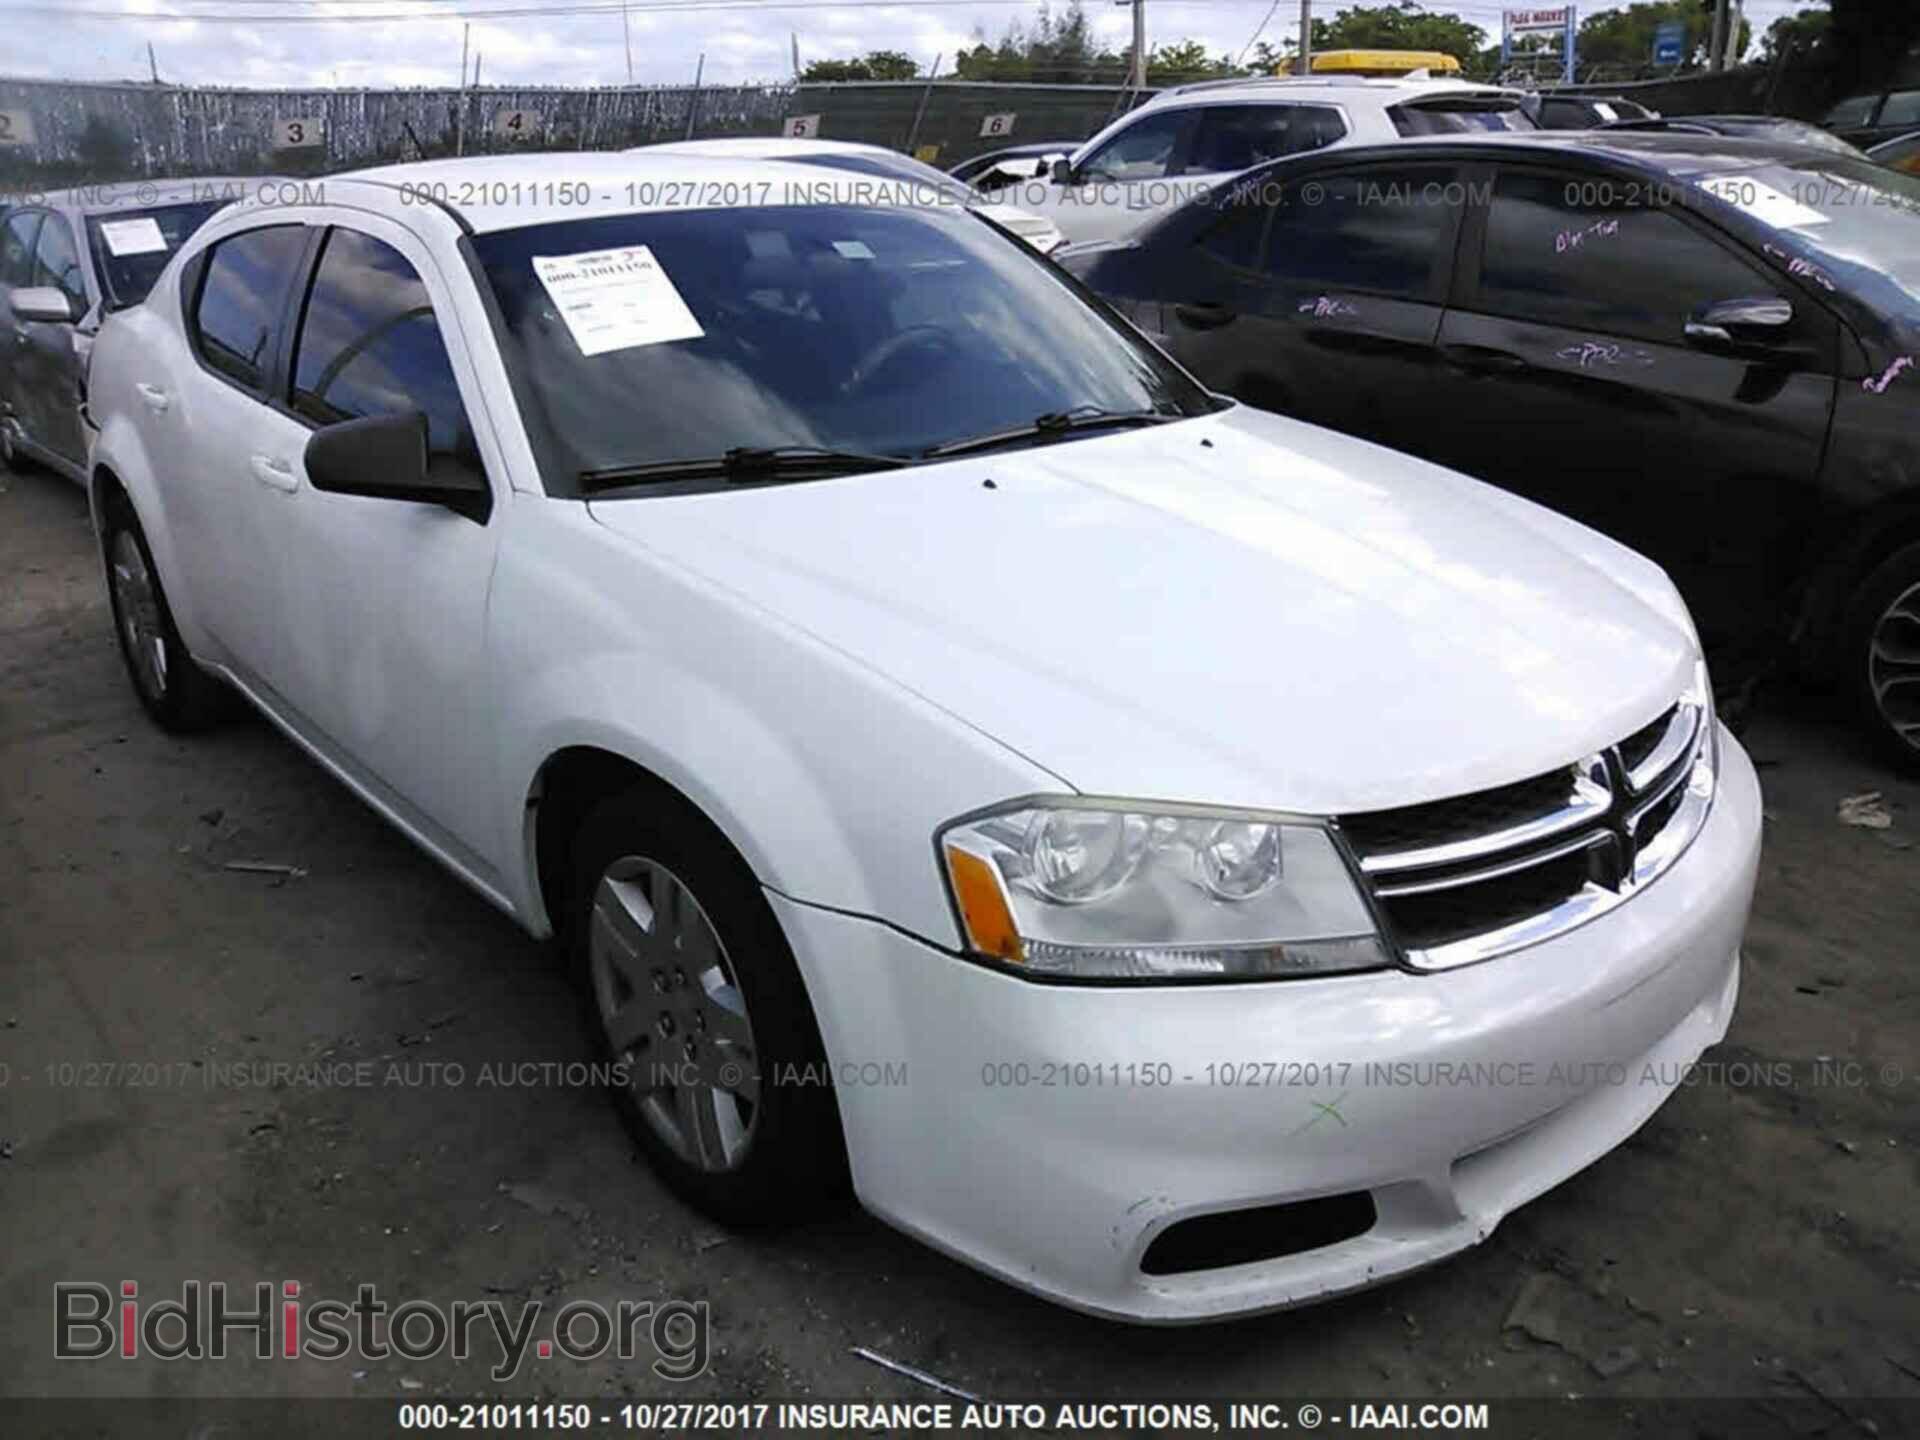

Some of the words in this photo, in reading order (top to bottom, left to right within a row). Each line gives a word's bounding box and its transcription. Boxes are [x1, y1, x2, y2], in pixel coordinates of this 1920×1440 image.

[0, 114, 15, 140] 2
[507, 113, 523, 130] 4
[793, 119, 806, 138] 5
[990, 117, 1002, 134] 6
[287, 122, 305, 143] 3
